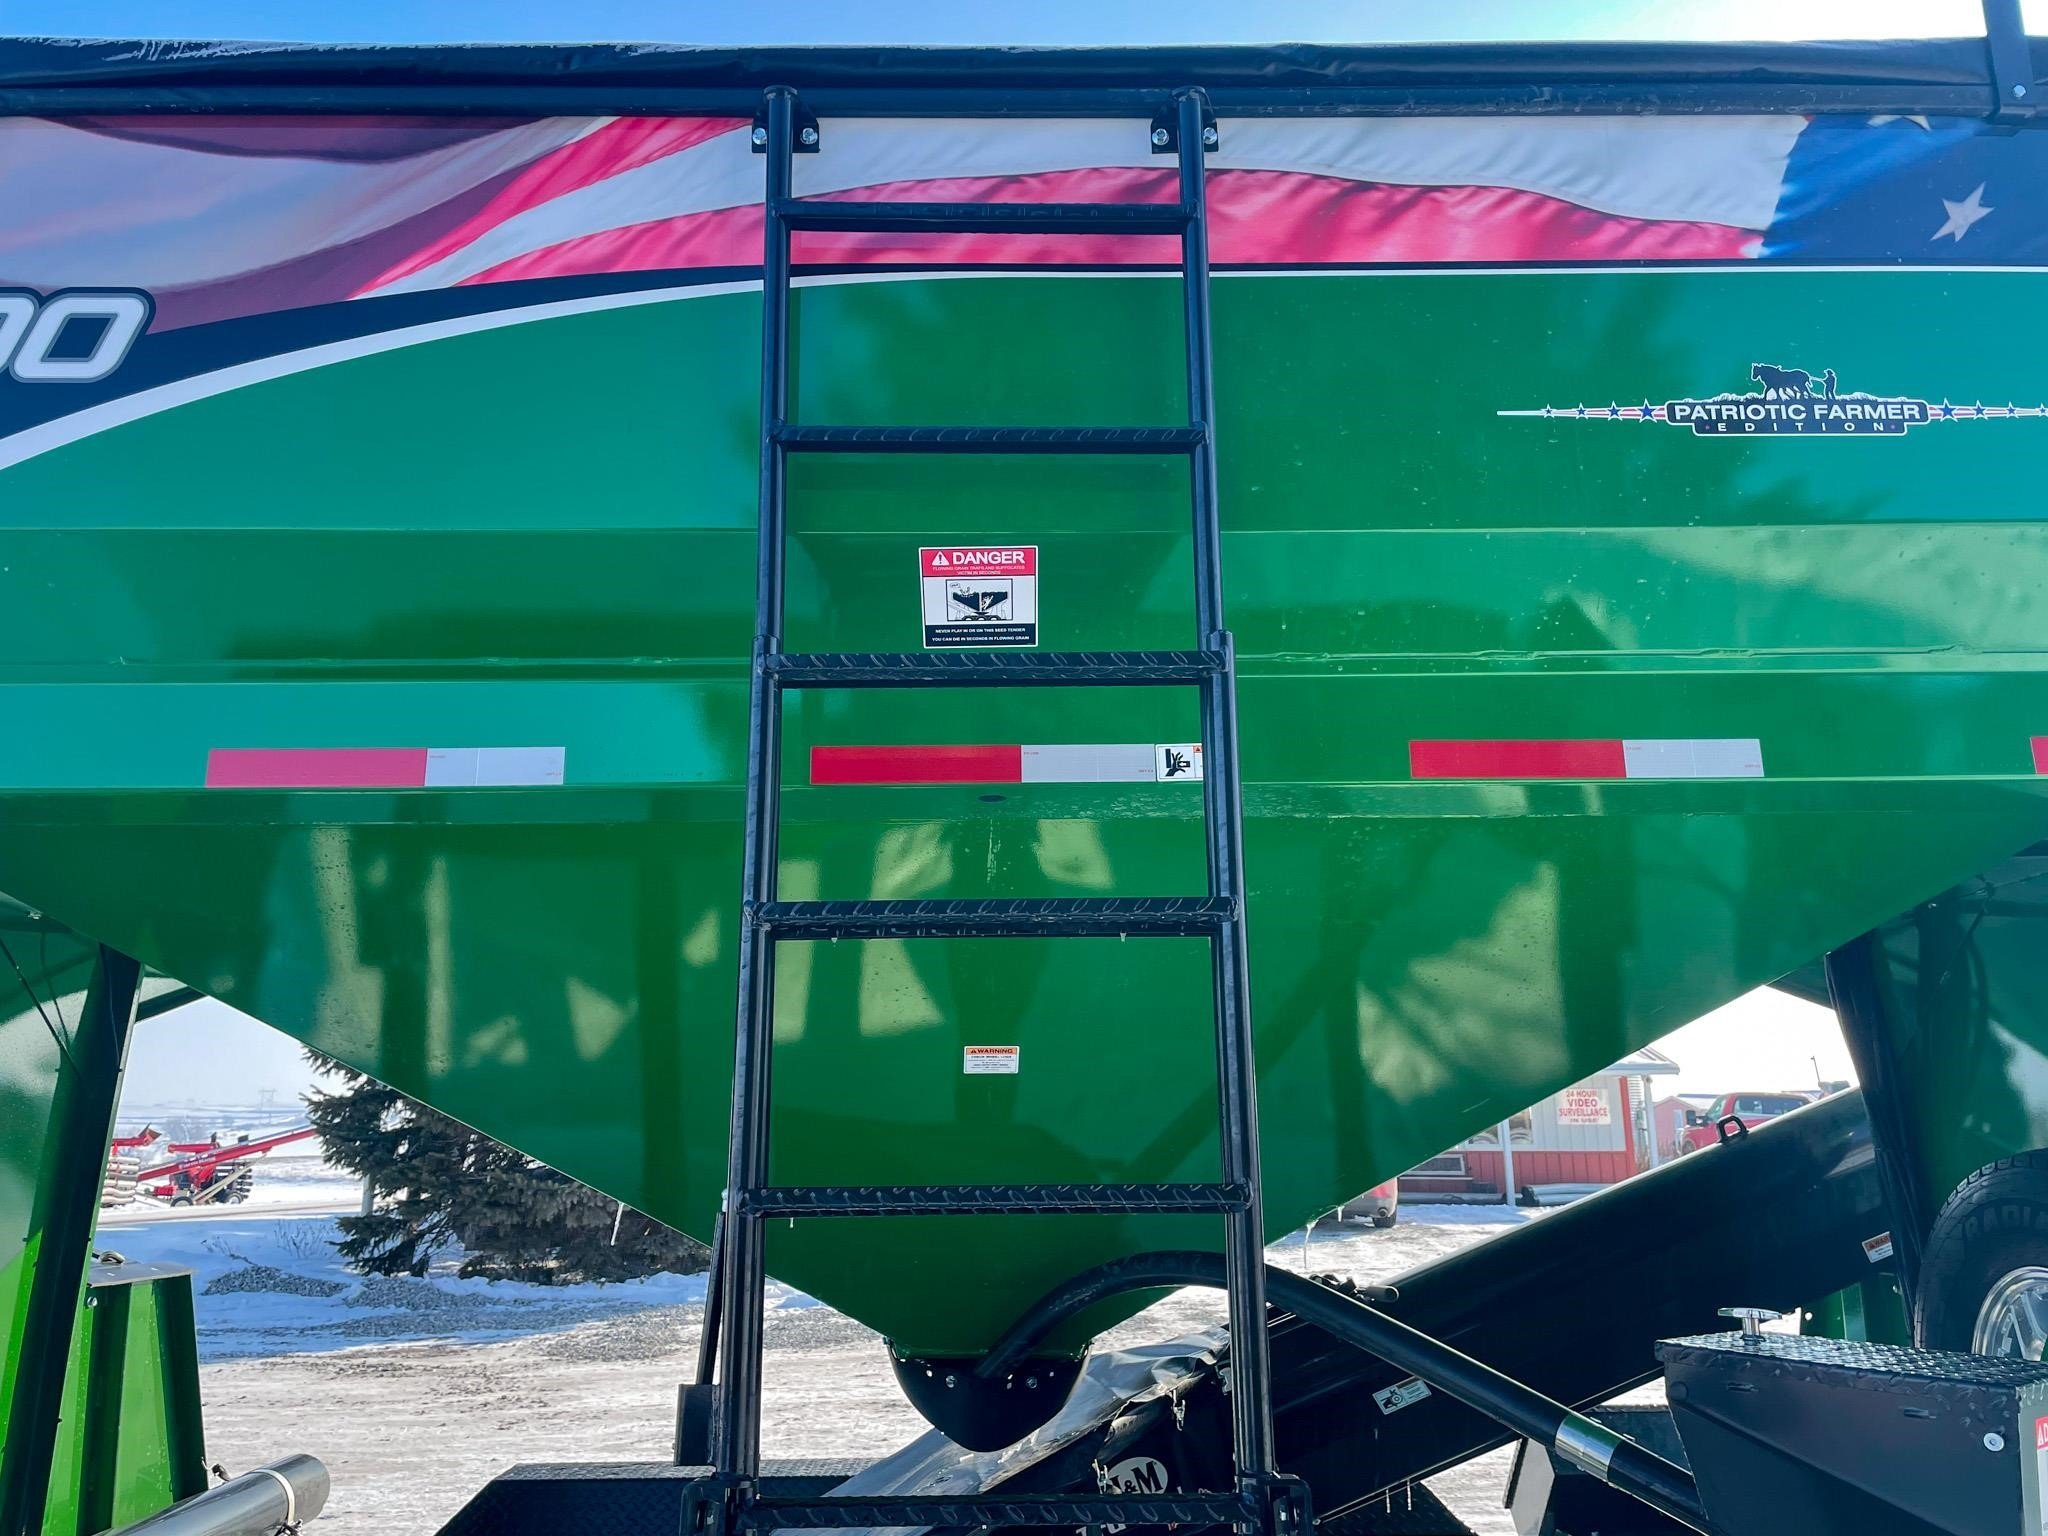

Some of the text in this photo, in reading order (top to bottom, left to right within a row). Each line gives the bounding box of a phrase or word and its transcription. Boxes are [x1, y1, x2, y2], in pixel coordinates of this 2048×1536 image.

[0, 292, 150, 384] 0
[1674, 404, 1921, 421] PATRIOTIC FARMER
[1717, 422, 1884, 432] EDITION
[952, 551, 1026, 565] DANGER
[1566, 1089, 1597, 1098] 24 HOUR
[1567, 1098, 1598, 1107] VIDEO
[1558, 1107, 1608, 1117] SURVEILLANCE
